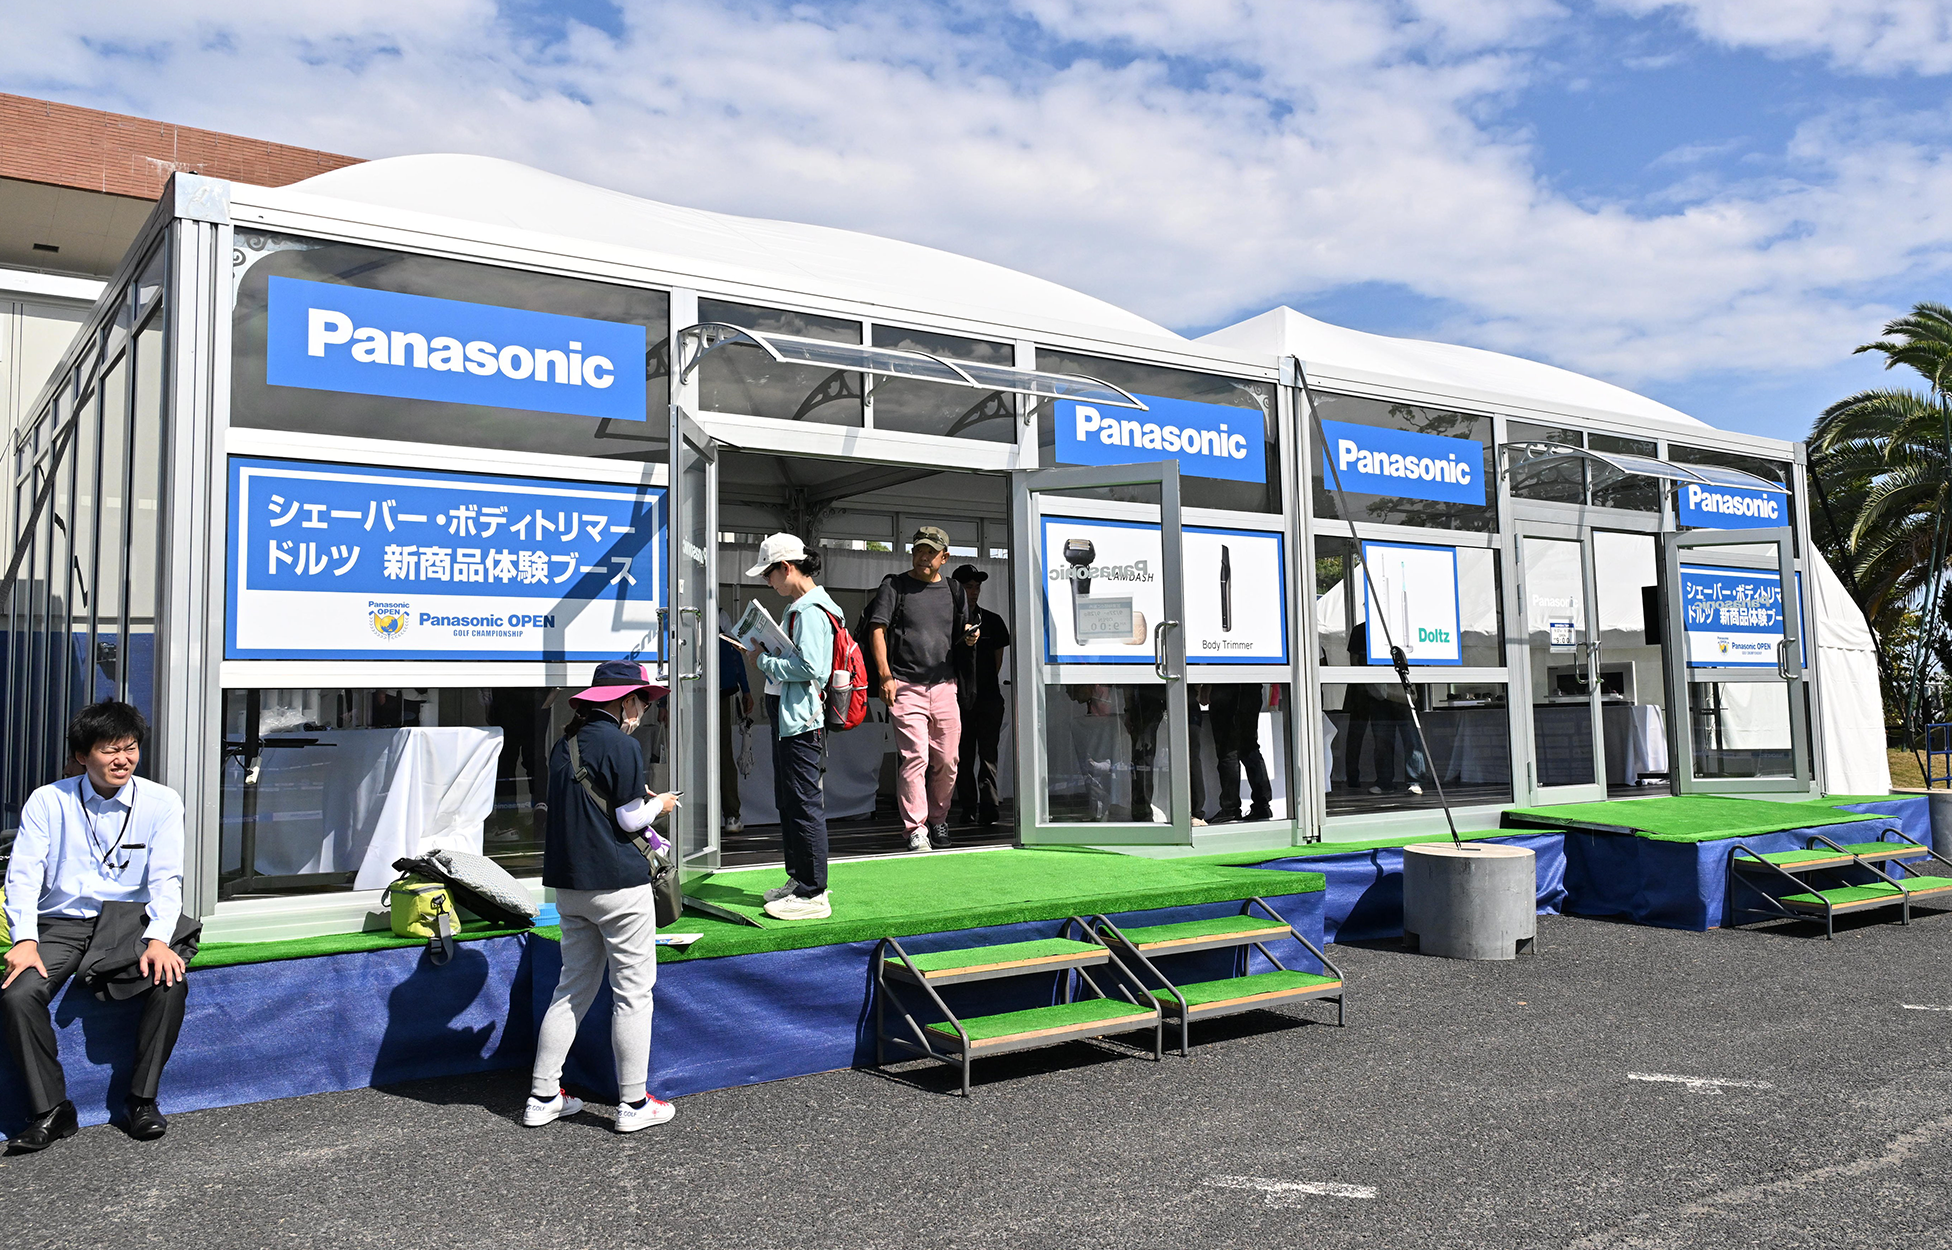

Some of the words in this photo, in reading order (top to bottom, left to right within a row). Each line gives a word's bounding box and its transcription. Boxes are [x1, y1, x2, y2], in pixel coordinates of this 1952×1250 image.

[307, 307, 615, 389] Panasonic
[1075, 405, 1248, 460] Panasonic
[1338, 438, 1471, 485] Panasonic
[1688, 483, 1779, 520] Panasonic
[268, 494, 635, 543] シェーバー・ボディトリマー
[268, 540, 361, 577] ドルツ
[383, 543, 637, 586] 新商品体験ブース
[368, 601, 410, 609] Panasonic
[1532, 594, 1579, 608] Panasonic
[377, 608, 400, 616] OPEN
[419, 612, 503, 627] Panasonic
[508, 614, 555, 628] OPEN
[453, 629, 470, 637] GOLF
[472, 630, 523, 638] CHAMPIONSHIP
[1418, 627, 1450, 643] Doltz
[1202, 639, 1221, 652] Body
[1222, 639, 1254, 650] Trimmer
[1757, 642, 1771, 651] OPEN
